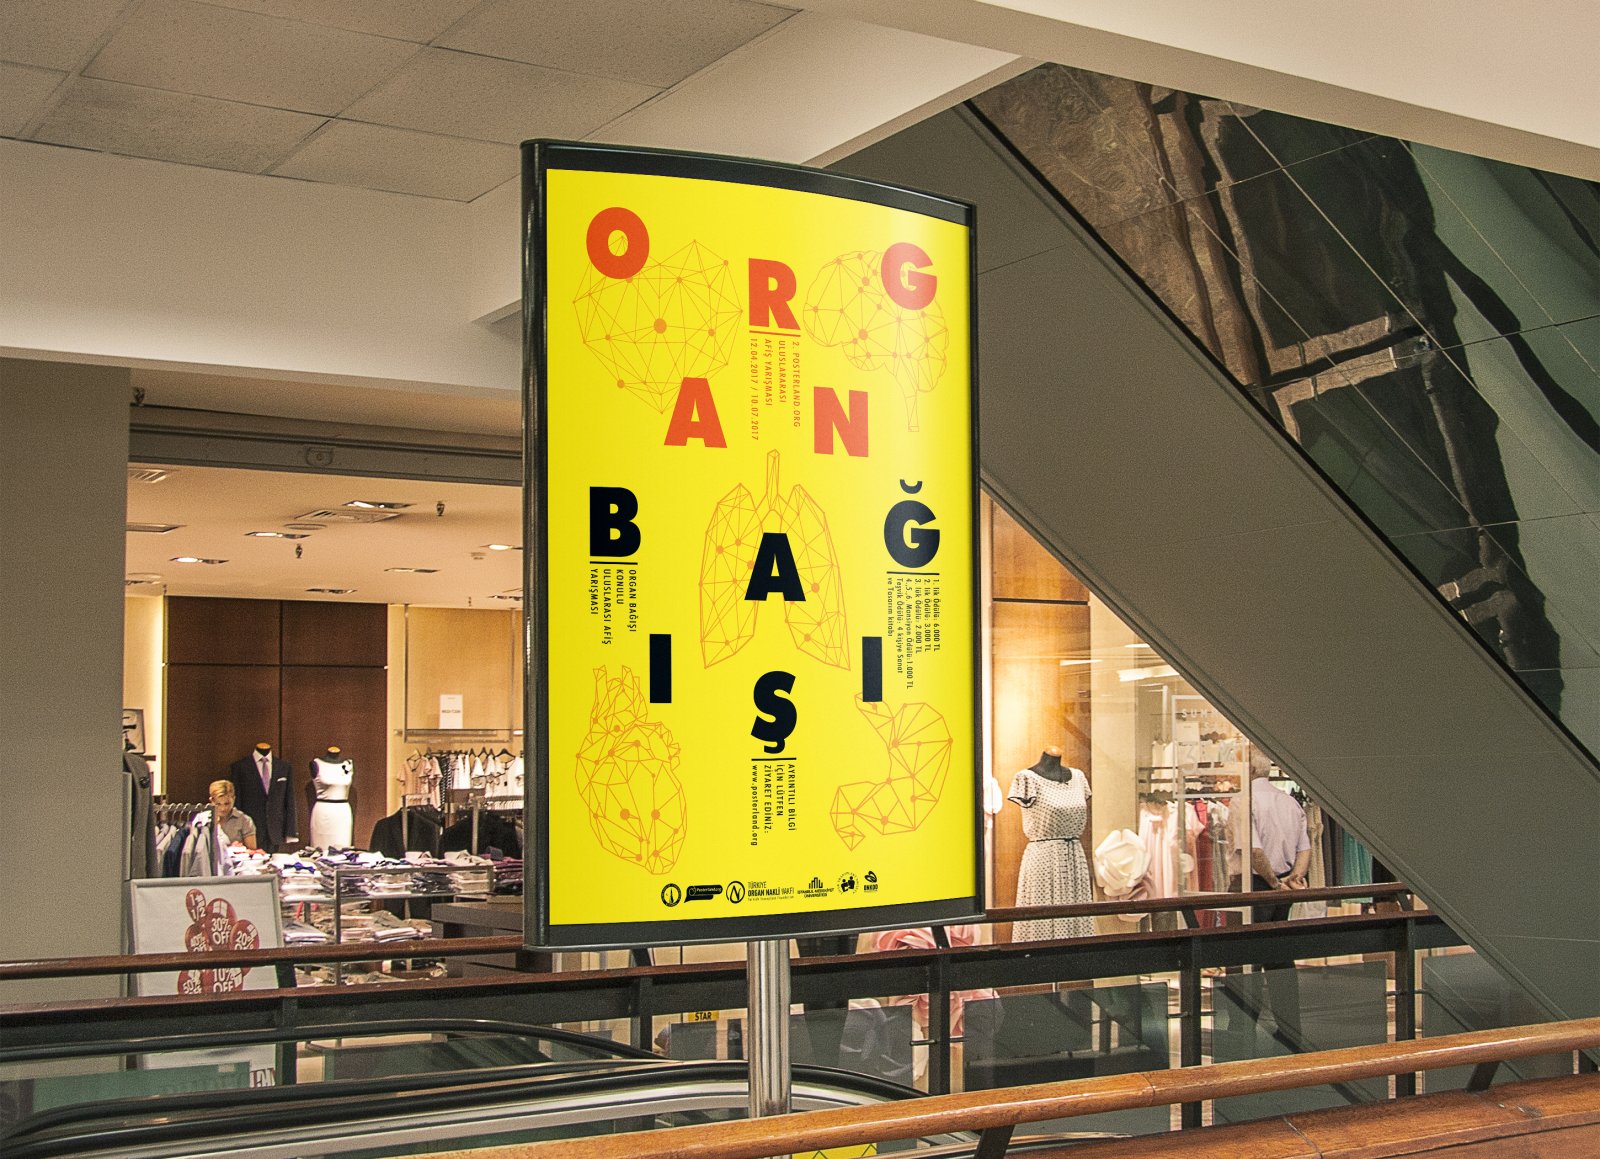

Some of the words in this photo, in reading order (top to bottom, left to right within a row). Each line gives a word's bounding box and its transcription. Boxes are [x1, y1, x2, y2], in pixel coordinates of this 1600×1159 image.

[586, 207, 650, 279] O
[748, 258, 800, 330] R
[881, 243, 937, 310] G
[763, 339, 773, 357] AFİŞ
[792, 341, 799, 349] 2.
[750, 338, 758, 383] 12.04.2017
[763, 362, 772, 406] YARIŞMASI
[664, 377, 727, 448] A
[813, 386, 869, 457] N
[751, 395, 759, 440] 10.07.2017
[590, 486, 641, 558] B
[744, 533, 806, 602] A
[884, 479, 940, 568] Ğ
[589, 569, 598, 615] YARIŞMASI
[616, 569, 624, 605] KONULU
[627, 603, 638, 632] BAĞIŞI
[897, 601, 905, 624] Ödülü:
[915, 600, 923, 622] Ödülü:
[924, 598, 932, 620] Ödülü:
[933, 598, 941, 620] Ödülü:
[602, 626, 613, 645] AFİŞ
[925, 644, 931, 652] TL
[934, 644, 940, 652] TL
[907, 681, 913, 689] TL
[750, 670, 797, 754] Ş
[764, 765, 773, 798] ZİYARET
[775, 765, 785, 781] İÇİN
[751, 765, 759, 846] www.posterland.org
[777, 785, 785, 816] LÜTFEN
[764, 802, 773, 833] EDİNİZ:
[788, 809, 797, 831] BİLGİ
[766, 887, 780, 895] NAKLİ
[211, 918, 231, 931] 30%
[213, 931, 230, 945] OFF
[214, 968, 235, 982] 10%
[695, 1012, 712, 1020] STAR
